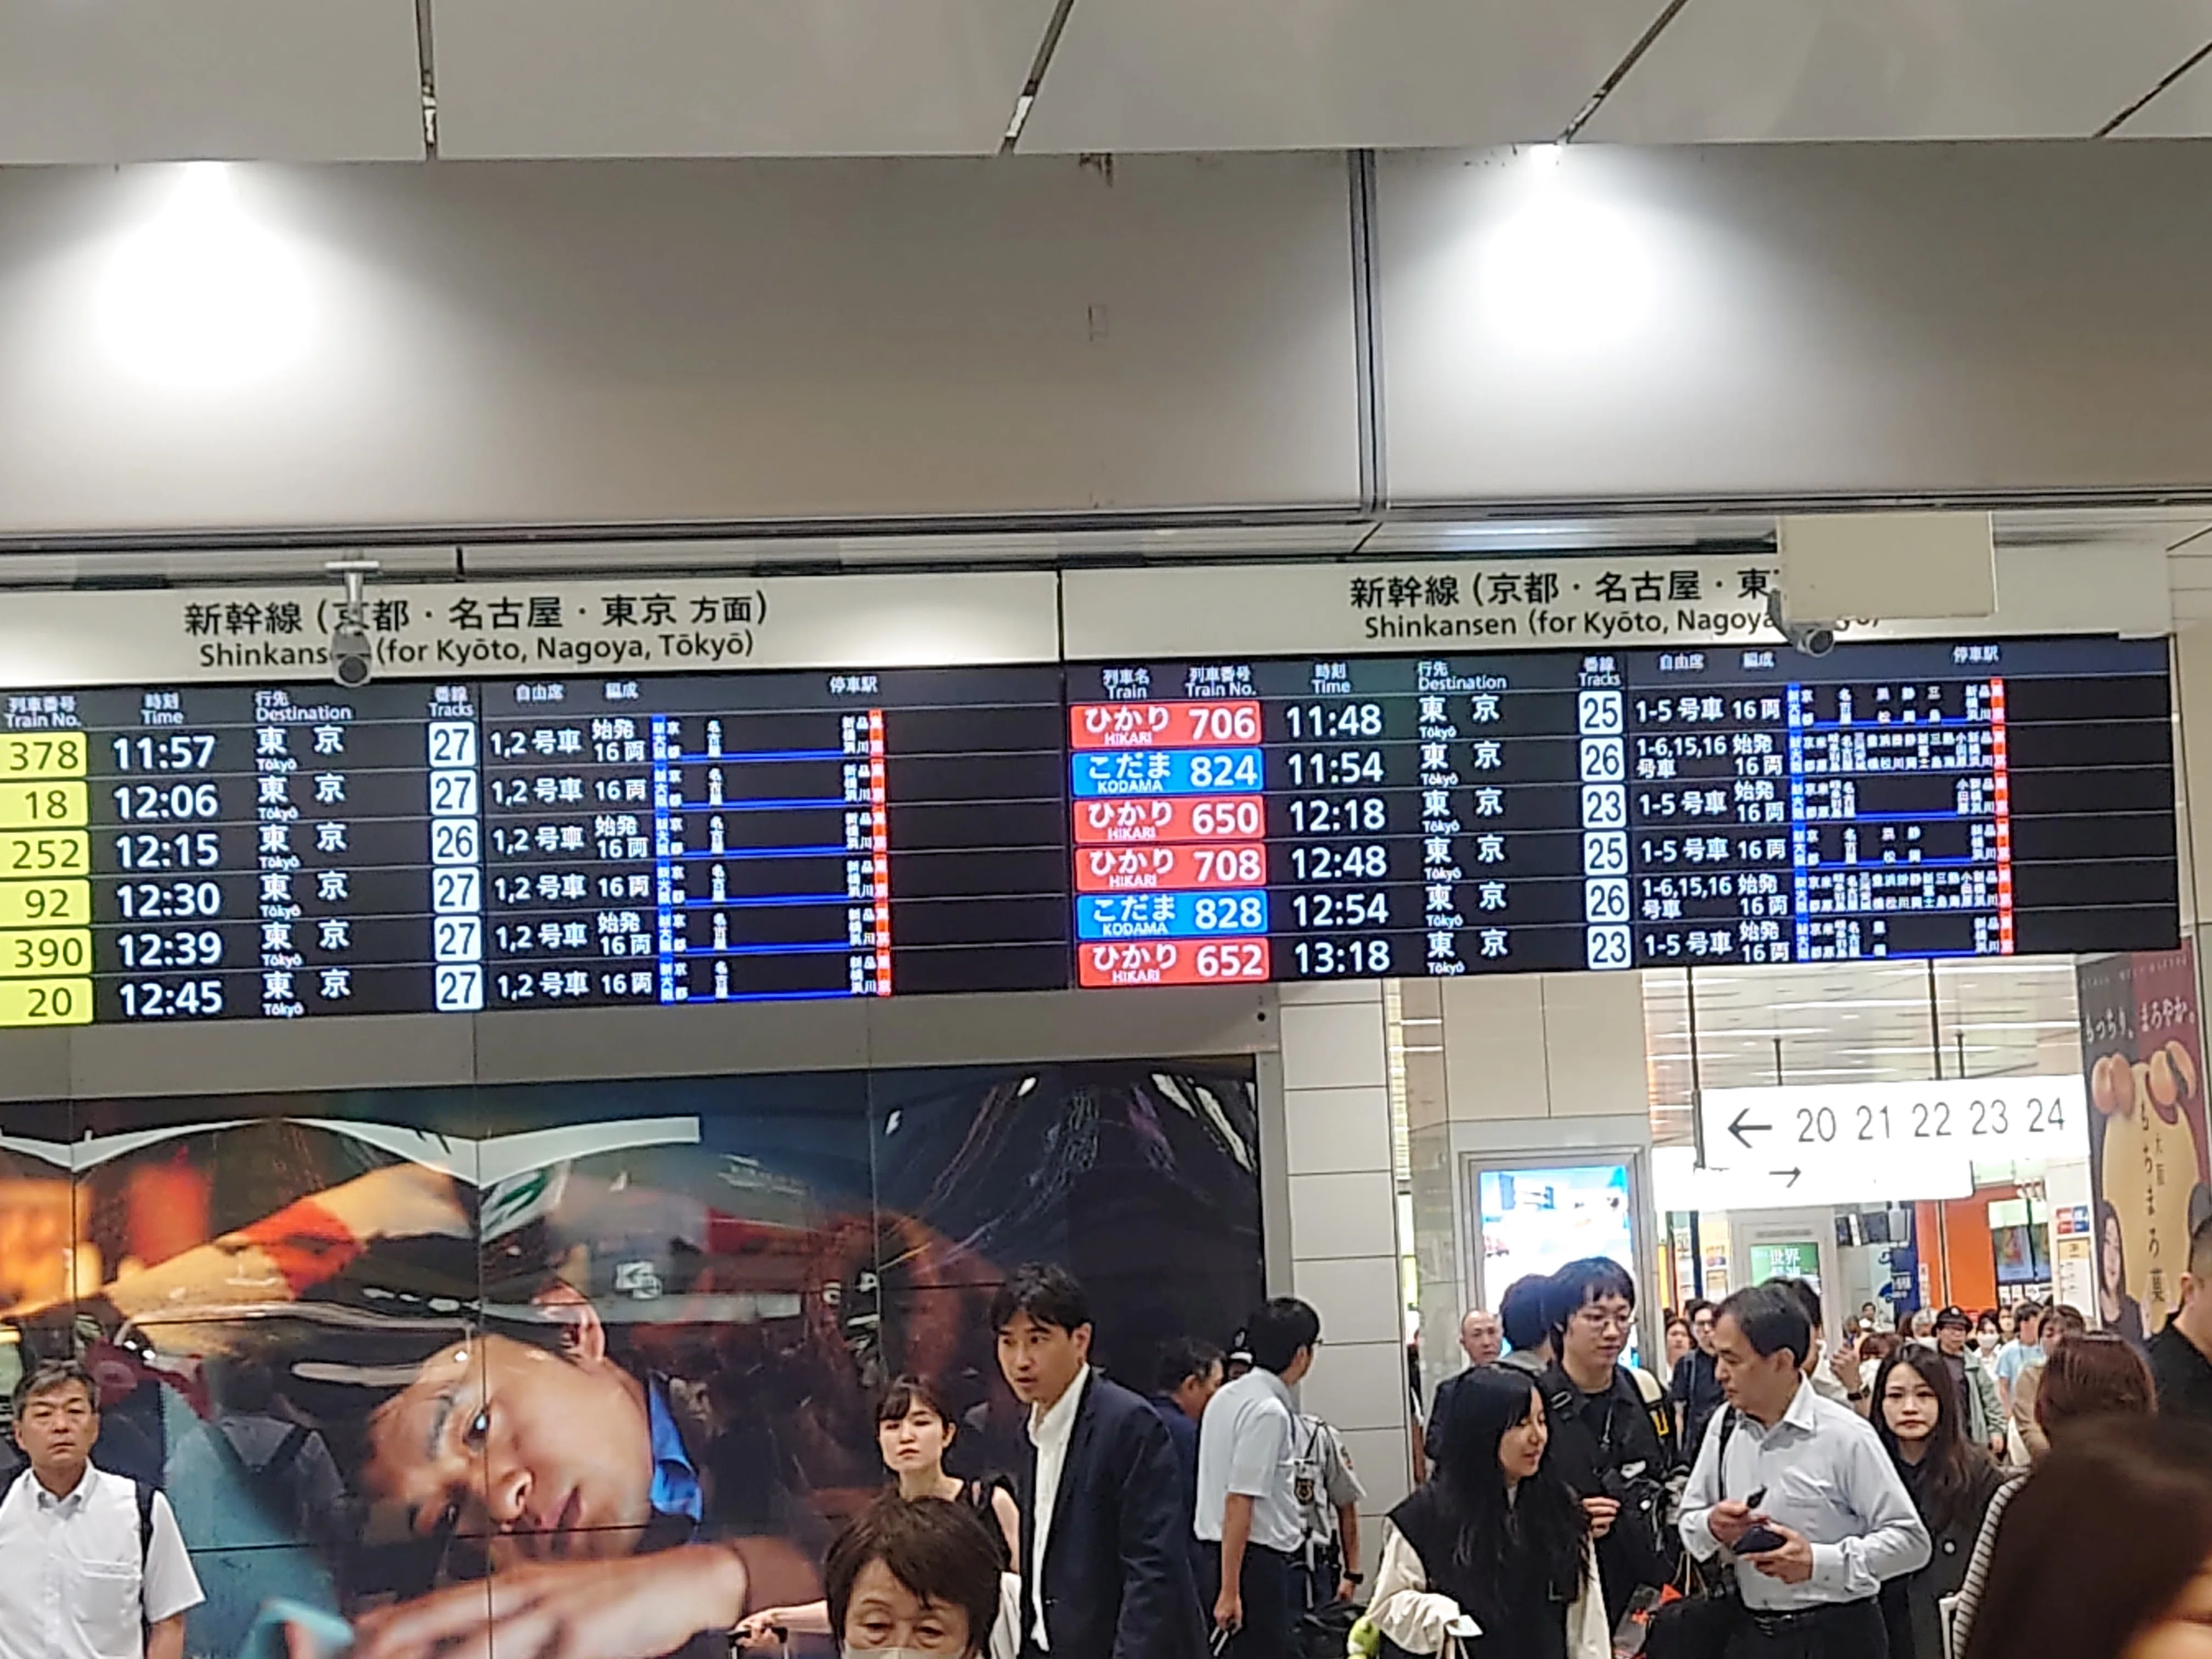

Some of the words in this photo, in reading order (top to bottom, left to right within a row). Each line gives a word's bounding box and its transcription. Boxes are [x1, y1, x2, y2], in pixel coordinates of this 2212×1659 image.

[1365, 613, 1517, 639] Shinkansen
[1528, 611, 1577, 637] (for
[200, 643, 328, 668] Shinkans
[377, 636, 427, 666] (for
[538, 634, 651, 664] Nagoya,
[1103, 669, 1149, 685] 列車名
[1418, 661, 1447, 676] 行先
[1312, 679, 1351, 693] Time
[1418, 674, 1507, 691] Destination
[1579, 672, 1621, 687] Tracks
[1105, 684, 1147, 700] Train
[1186, 682, 1231, 698] Train
[1233, 681, 1256, 696] No.
[256, 691, 288, 707] 行先
[142, 710, 184, 724] Time
[256, 705, 353, 721] Destination
[429, 701, 473, 717] Tracks
[7, 713, 53, 728] Train
[55, 712, 81, 727] No.
[1085, 706, 1169, 732] ひかり
[1188, 709, 1256, 739] 706
[1286, 706, 1383, 737] 11:48
[1584, 697, 1619, 728] 25
[1104, 733, 1153, 745] HIKARI
[9, 741, 79, 770] 378
[113, 735, 216, 769] 11:57
[434, 731, 470, 760] 27
[1088, 753, 1171, 779] こだま
[1190, 755, 1257, 787] 824
[1288, 752, 1384, 785] 11:54
[1585, 744, 1620, 775] 26
[1098, 781, 1163, 793] KODAMA
[25, 790, 67, 819] 18
[114, 785, 218, 818] 12:06
[436, 778, 471, 809] 27
[1088, 801, 1173, 827] ひかり
[1192, 803, 1259, 834] 650
[1290, 799, 1386, 832] 12:18
[1587, 792, 1622, 822] 23
[1108, 827, 1156, 839] HIKARI
[13, 839, 81, 870] 252
[116, 833, 218, 867] 12:15
[436, 826, 473, 856] 26
[1090, 849, 1173, 874] ひかり
[1193, 850, 1261, 881] 708
[1292, 846, 1387, 879] 12:48
[1588, 841, 1623, 871] 25
[1109, 875, 1157, 887] HIKARI
[25, 889, 70, 918] 92
[116, 882, 219, 917] 12:30
[438, 874, 473, 905] 27
[1093, 896, 1175, 921] こだま
[1195, 898, 1262, 929] 828
[1293, 893, 1389, 926] 12:54
[1590, 887, 1625, 917] 26
[1102, 923, 1167, 936] KODAMA
[14, 938, 83, 968] 390
[117, 932, 222, 967] 12:39
[439, 923, 475, 954] 27
[1093, 944, 1177, 969] ひかり
[1196, 945, 1263, 975] 652
[1295, 941, 1390, 973] 13:18
[1592, 933, 1627, 963] 23
[1111, 970, 1160, 983] HIKARI
[28, 988, 72, 1017] 20
[120, 981, 223, 1015] 12:45
[441, 972, 476, 1003] 27
[1797, 1106, 1837, 1143] 20
[1857, 1104, 1891, 1141] 21
[1912, 1101, 1952, 1138] 22
[1971, 1099, 2009, 1135] 23
[2027, 1097, 2065, 1133] 24
